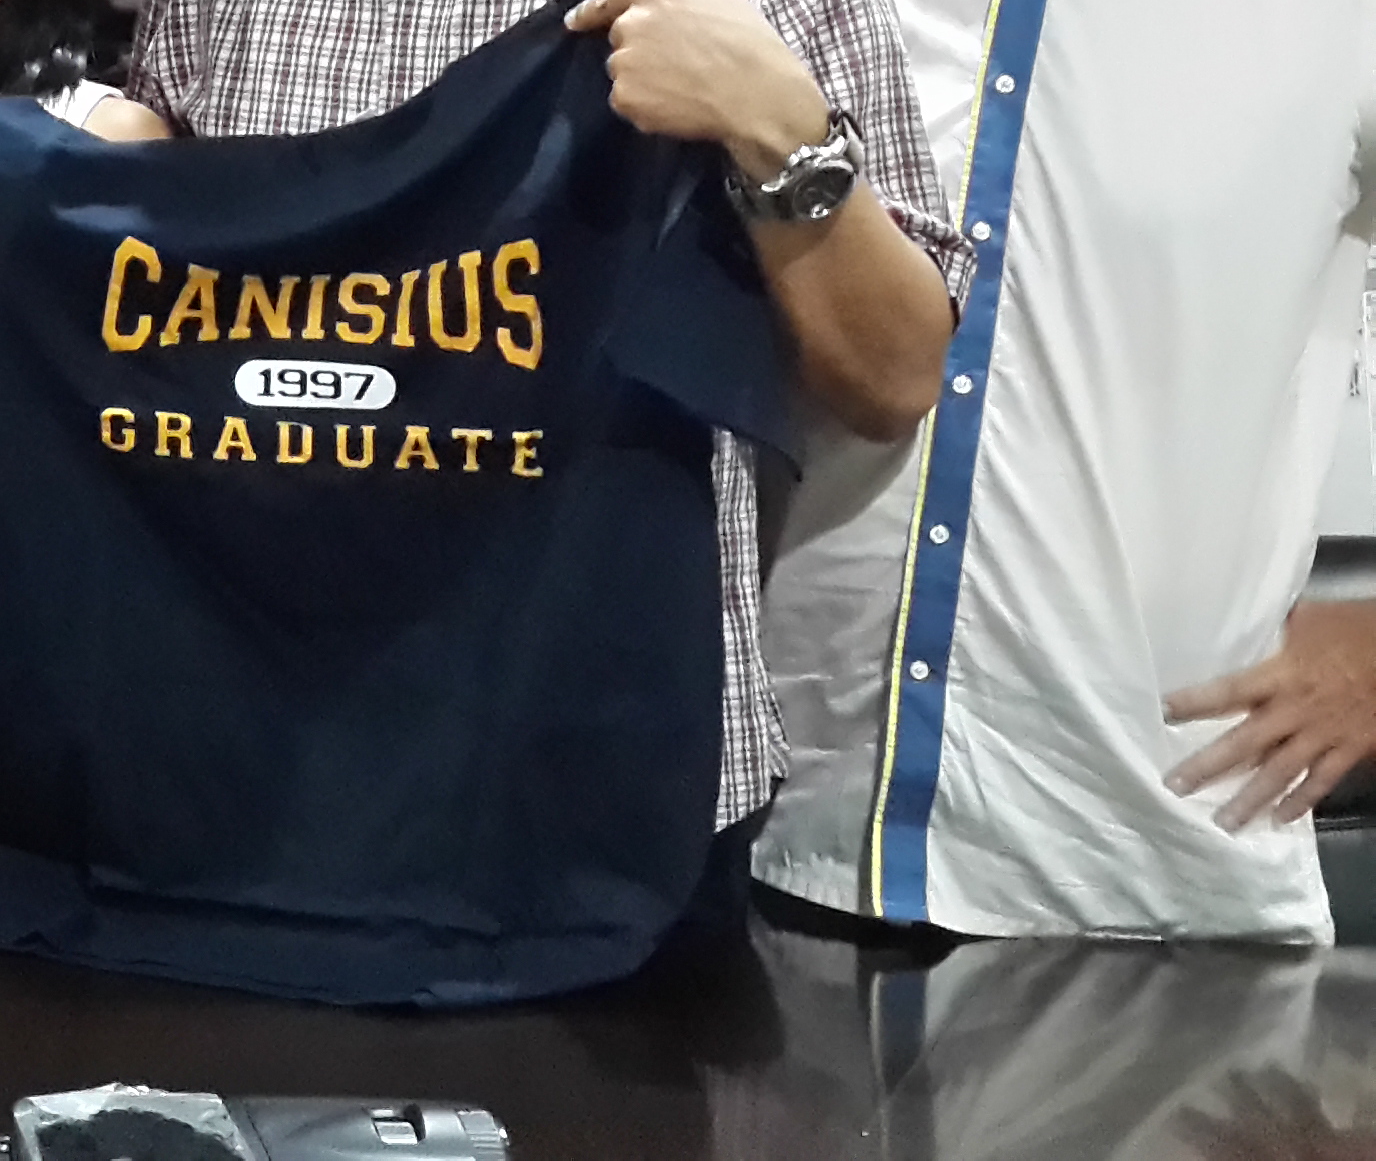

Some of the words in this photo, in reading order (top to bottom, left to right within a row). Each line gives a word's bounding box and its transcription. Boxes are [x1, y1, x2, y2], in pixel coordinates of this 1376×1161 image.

[100, 235, 544, 371] CANISIUS
[256, 367, 376, 401] 1997
[99, 406, 545, 478] GRADUATE
